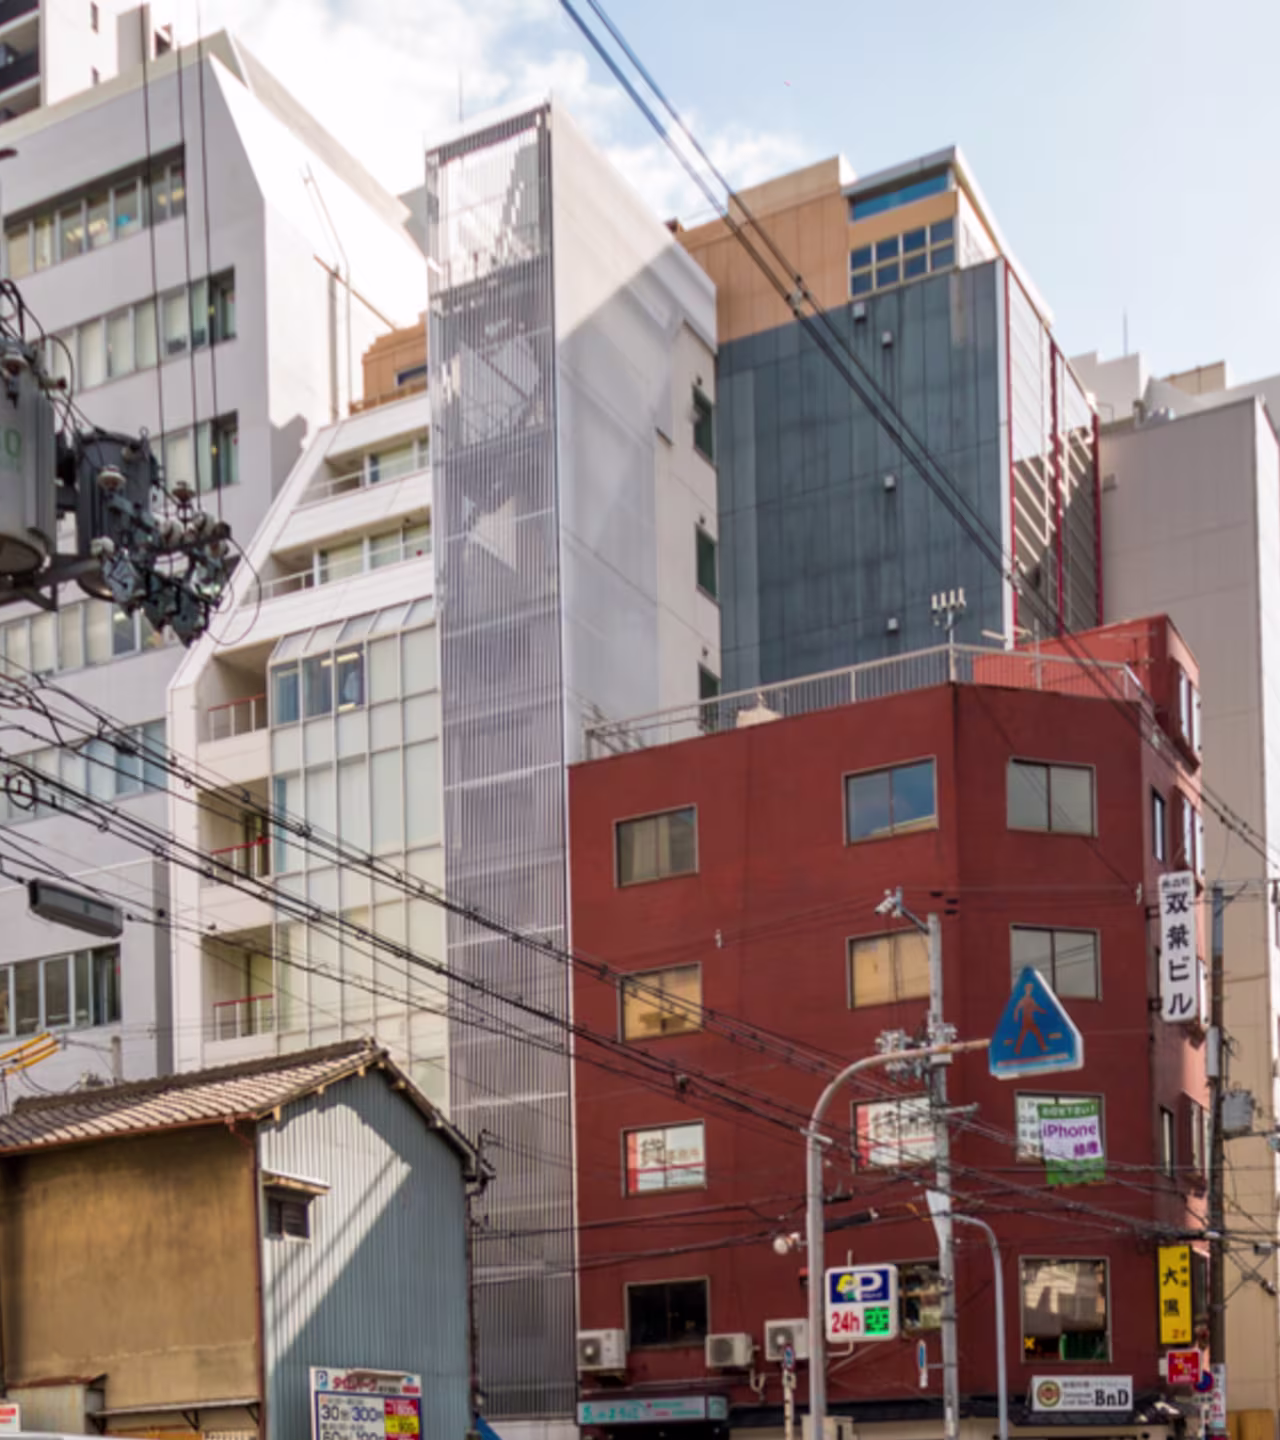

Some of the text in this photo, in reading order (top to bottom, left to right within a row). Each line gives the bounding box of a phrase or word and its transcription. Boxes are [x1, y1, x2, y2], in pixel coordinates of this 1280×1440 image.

[1043, 1122, 1097, 1139] iPhone
[831, 1311, 860, 1333] 24h
[1094, 1388, 1129, 1407] BnD
